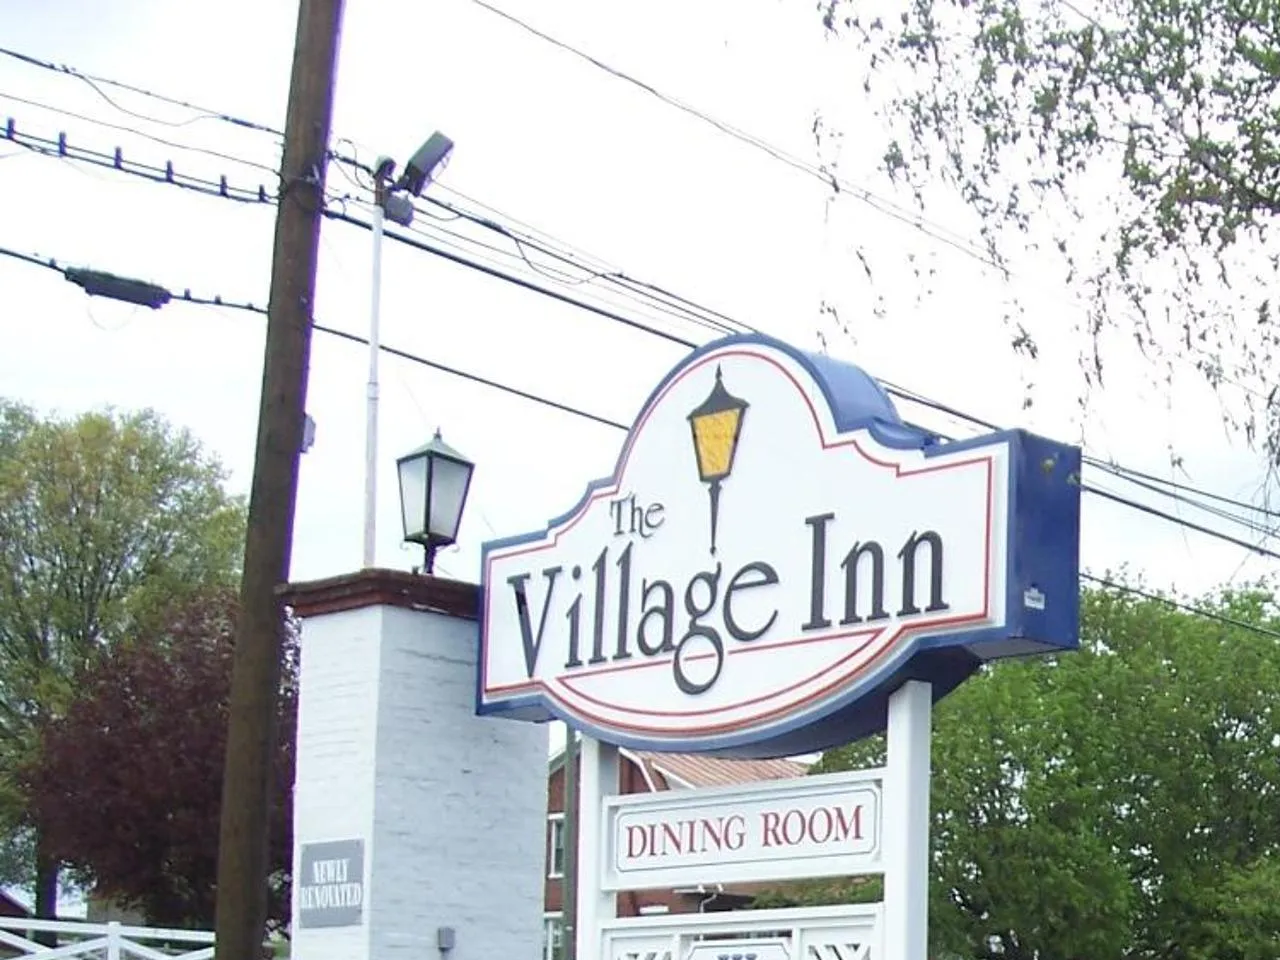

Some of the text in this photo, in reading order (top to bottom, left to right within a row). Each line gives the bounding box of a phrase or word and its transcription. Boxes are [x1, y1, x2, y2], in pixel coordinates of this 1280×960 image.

[610, 496, 665, 538] The
[507, 512, 949, 695] Village Inn
[626, 805, 865, 859] DINING ROOM
